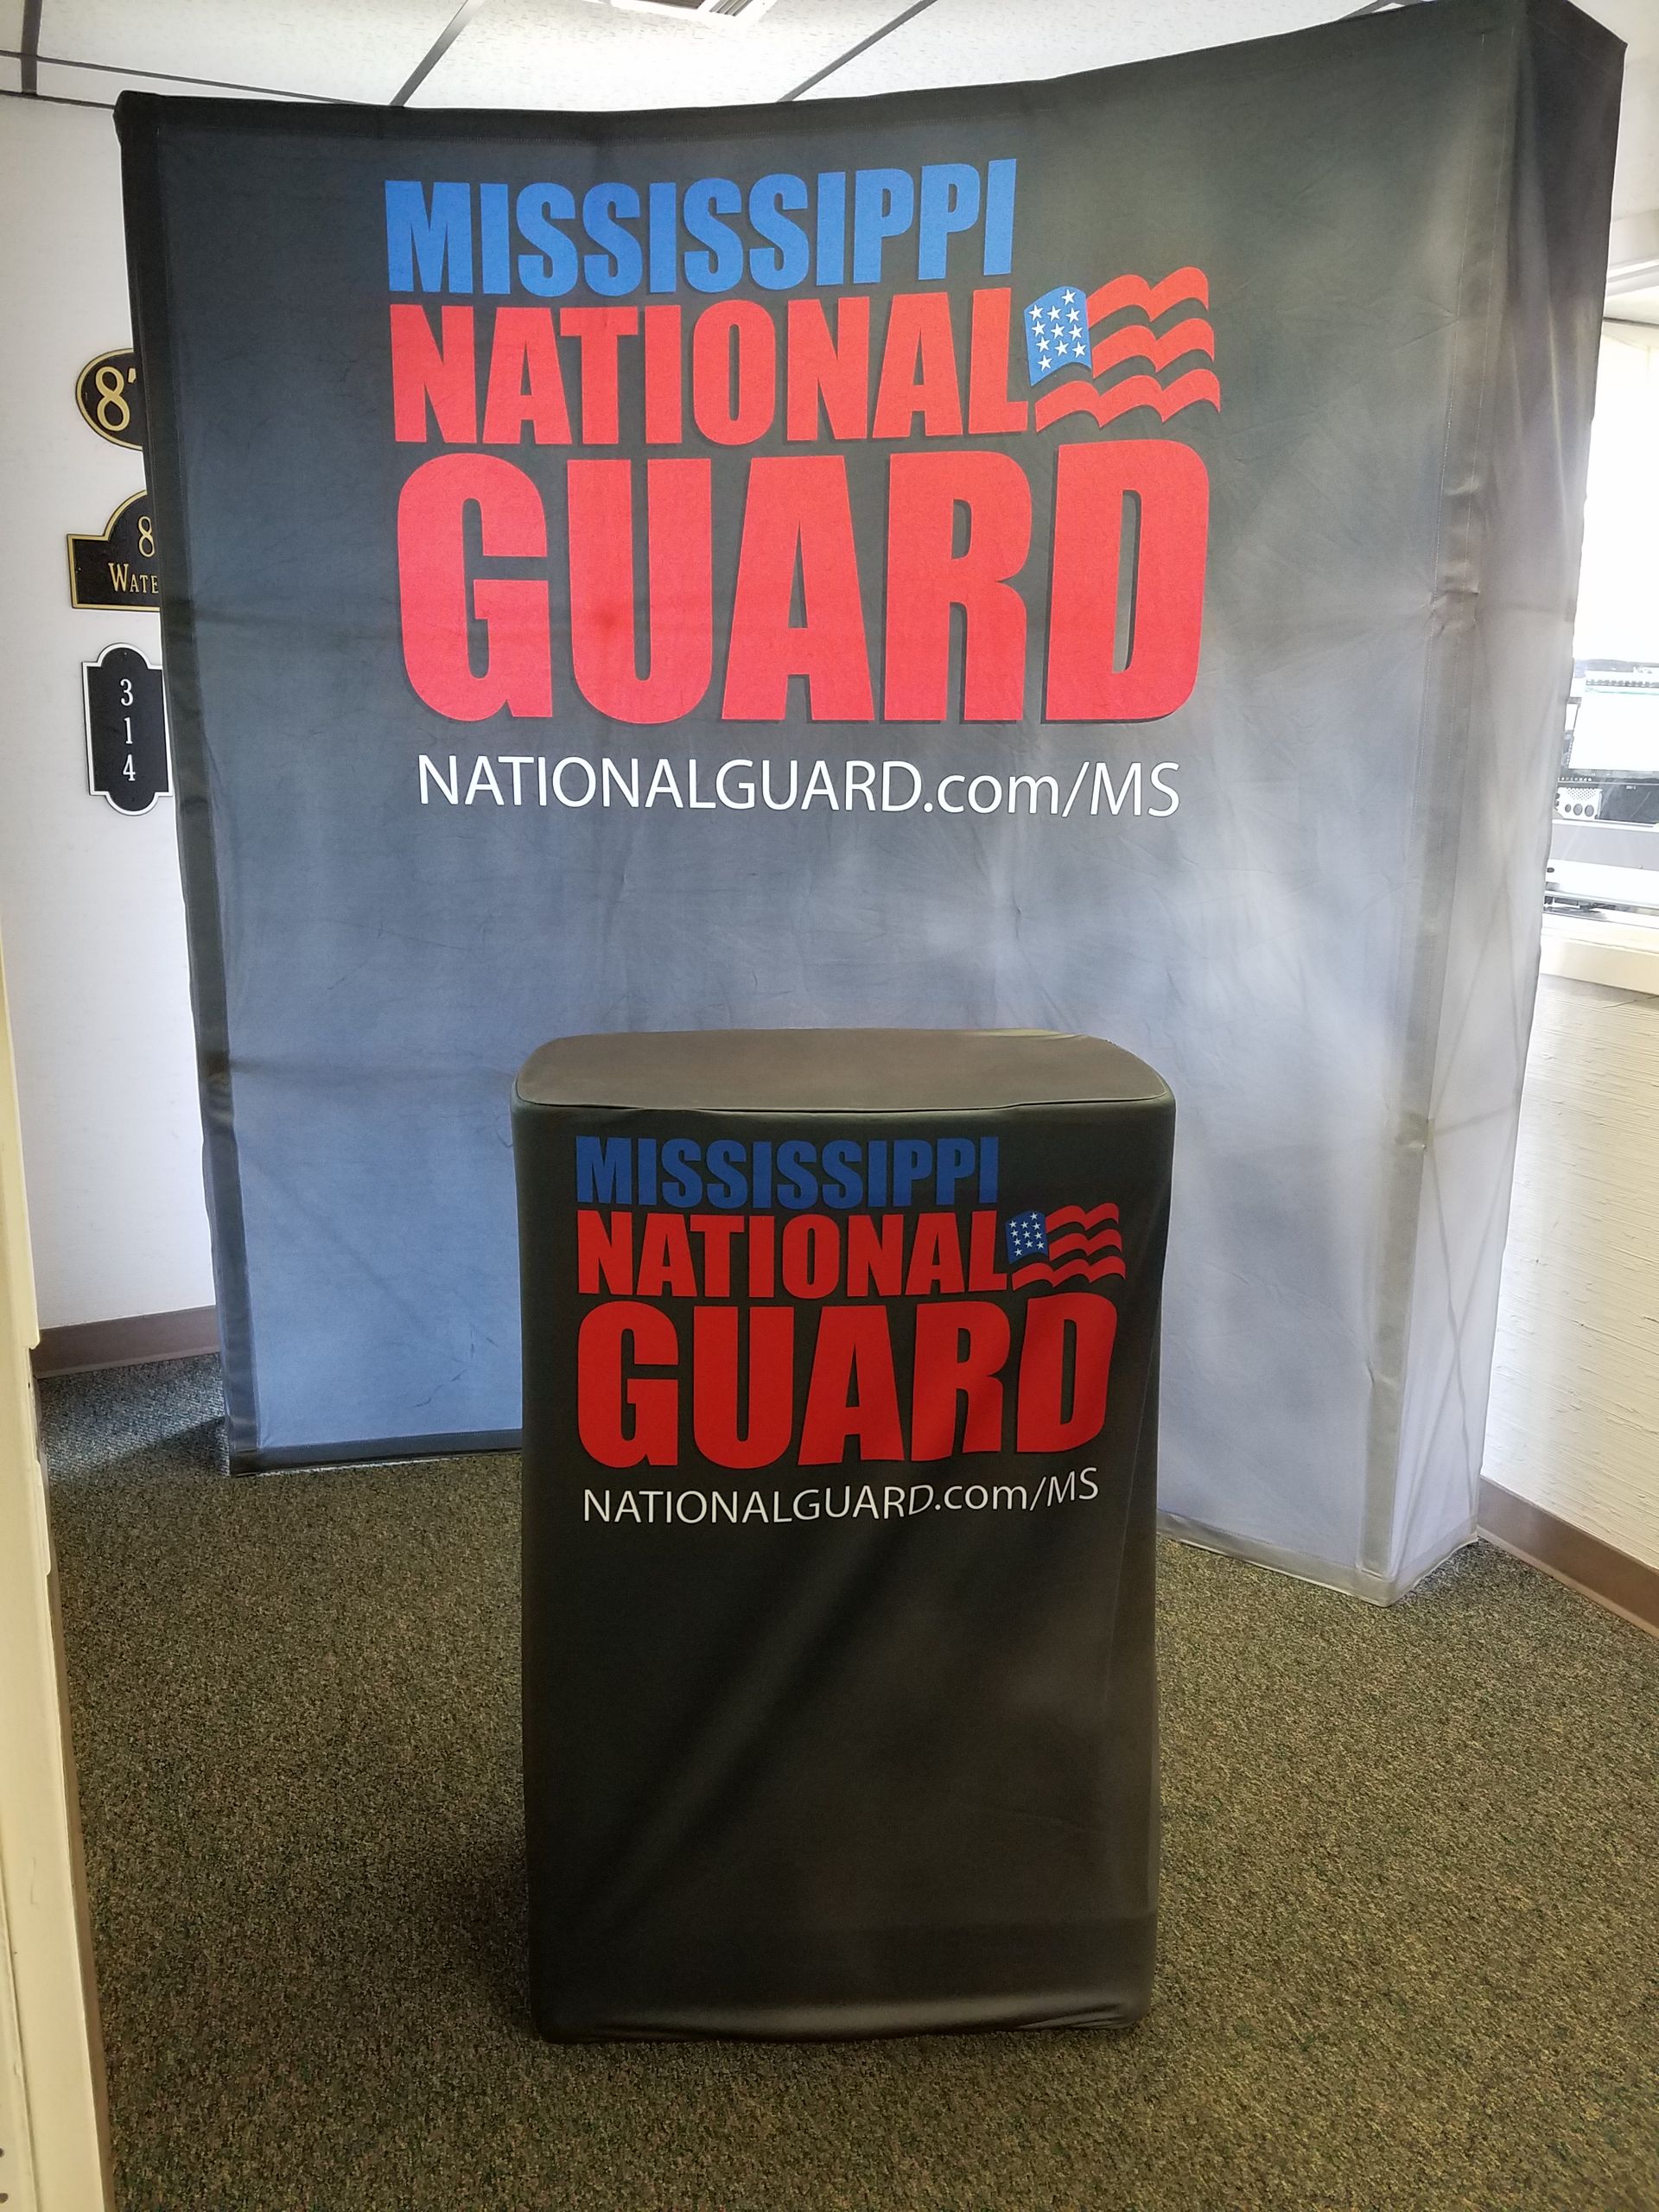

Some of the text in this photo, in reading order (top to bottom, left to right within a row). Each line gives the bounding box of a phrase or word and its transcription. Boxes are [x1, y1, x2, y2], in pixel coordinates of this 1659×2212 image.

[385, 158, 1017, 297] MISSISSIPPI
[95, 365, 137, 432] 8
[390, 287, 1029, 446] NATIONAL
[397, 439, 1211, 725] GUARD
[417, 753, 1181, 817] NATIONALGUARD.com/MS
[575, 1135, 1000, 1210] MISSISSIPPI
[576, 1210, 1008, 1300] NATIONAL
[577, 1292, 1119, 1469] GUARD
[582, 1466, 1100, 1524] NATIONALGUARD.com/MS
